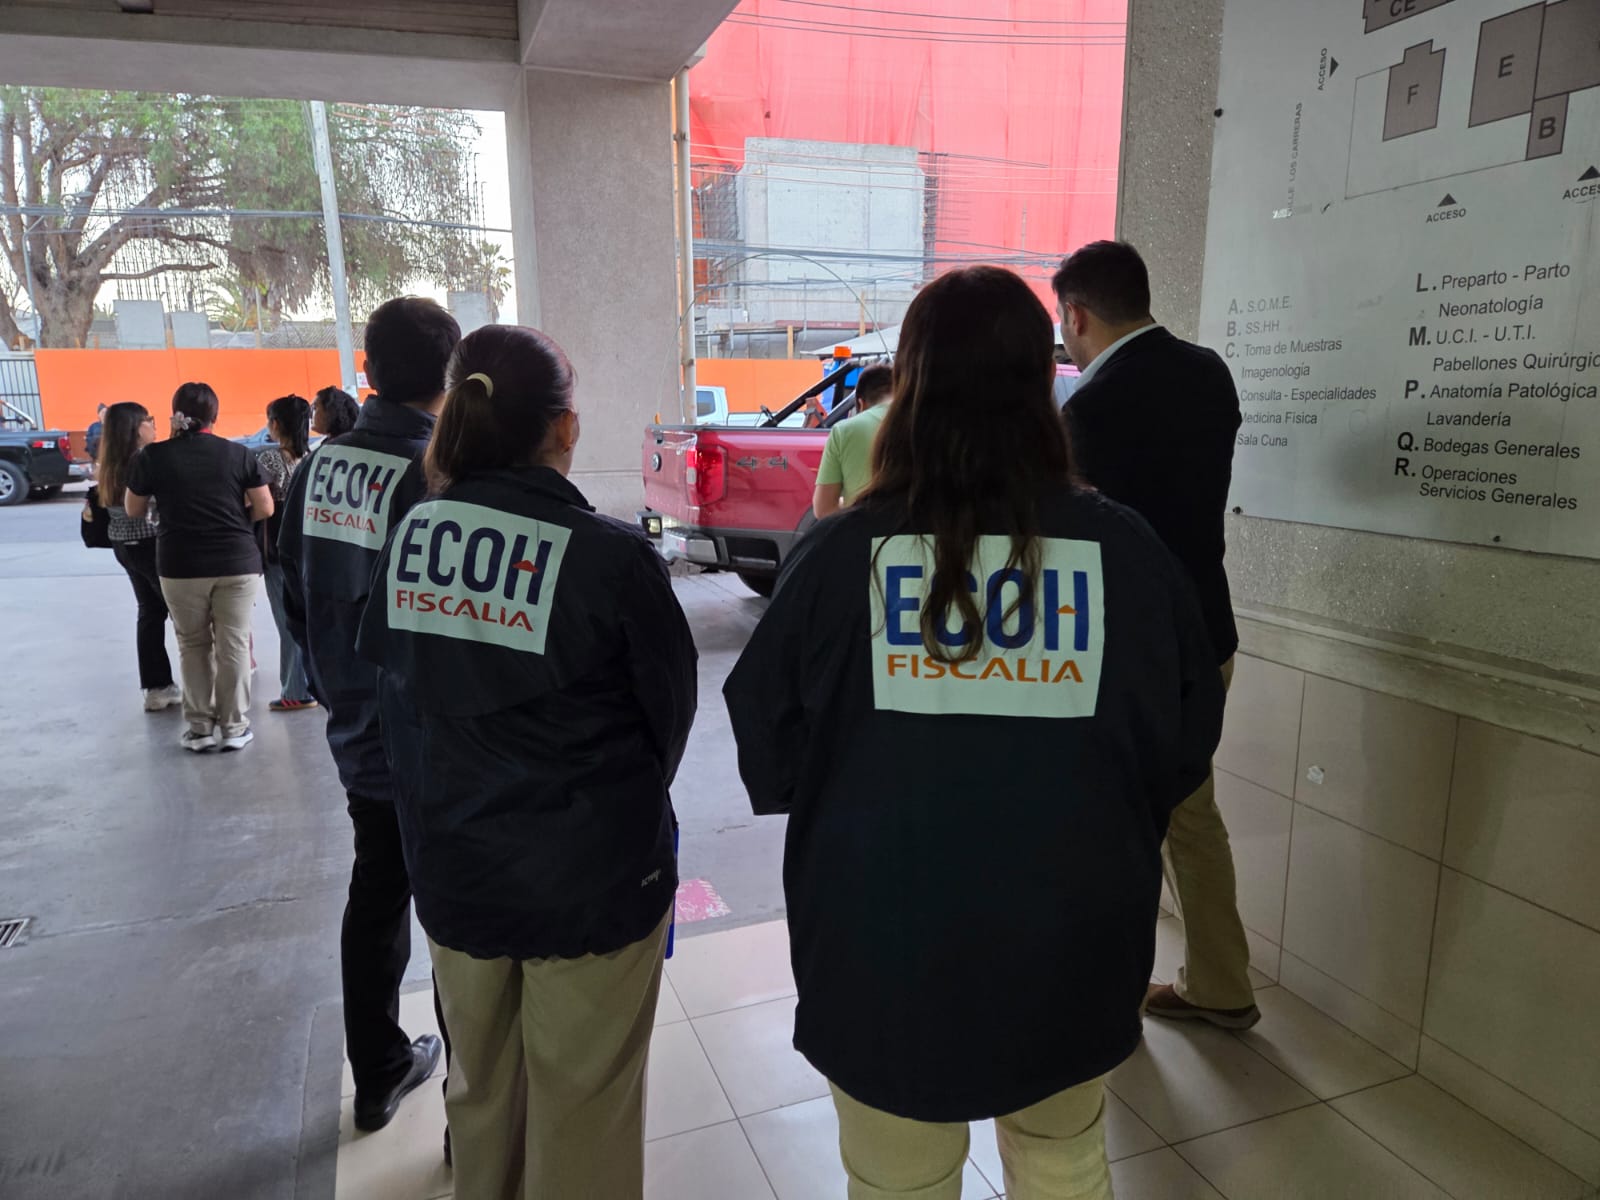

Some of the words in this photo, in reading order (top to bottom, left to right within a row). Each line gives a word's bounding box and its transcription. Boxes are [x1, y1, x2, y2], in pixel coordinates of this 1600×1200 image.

[1316, 48, 1328, 91] ACCESO
[1497, 54, 1515, 79] E
[1407, 84, 1419, 105] F
[1539, 116, 1557, 139] B
[1425, 207, 1467, 224] ACCESO
[1416, 273, 1437, 293] L.
[1441, 270, 1508, 291] Preparto
[1524, 262, 1571, 281] Parto
[1439, 295, 1544, 318] Neonatología
[1408, 326, 1432, 346] M.
[1244, 343, 1272, 357] Toma
[1274, 341, 1288, 355] de
[1290, 338, 1343, 353] Muestras
[1241, 362, 1311, 381] Imagenología
[1433, 355, 1518, 372] Pabellones
[1240, 388, 1282, 402] Consulta
[1291, 387, 1377, 403] Especialidades
[1430, 383, 1503, 399] Anatomía
[1508, 382, 1598, 402] Patológica
[1427, 411, 1512, 427] Lavandería
[1237, 433, 1258, 446] Sala
[1261, 433, 1288, 447] Cuna
[1423, 437, 1489, 457] Bodegas
[1494, 439, 1581, 459] Generales
[1421, 464, 1518, 485] Operaciones
[309, 456, 397, 515] ECOH
[1419, 482, 1487, 501] Servicios
[1491, 488, 1578, 510] Generales
[396, 518, 553, 606] ECOH
[396, 589, 535, 632] FISCALIA
[887, 654, 1084, 683] FISCALIA
